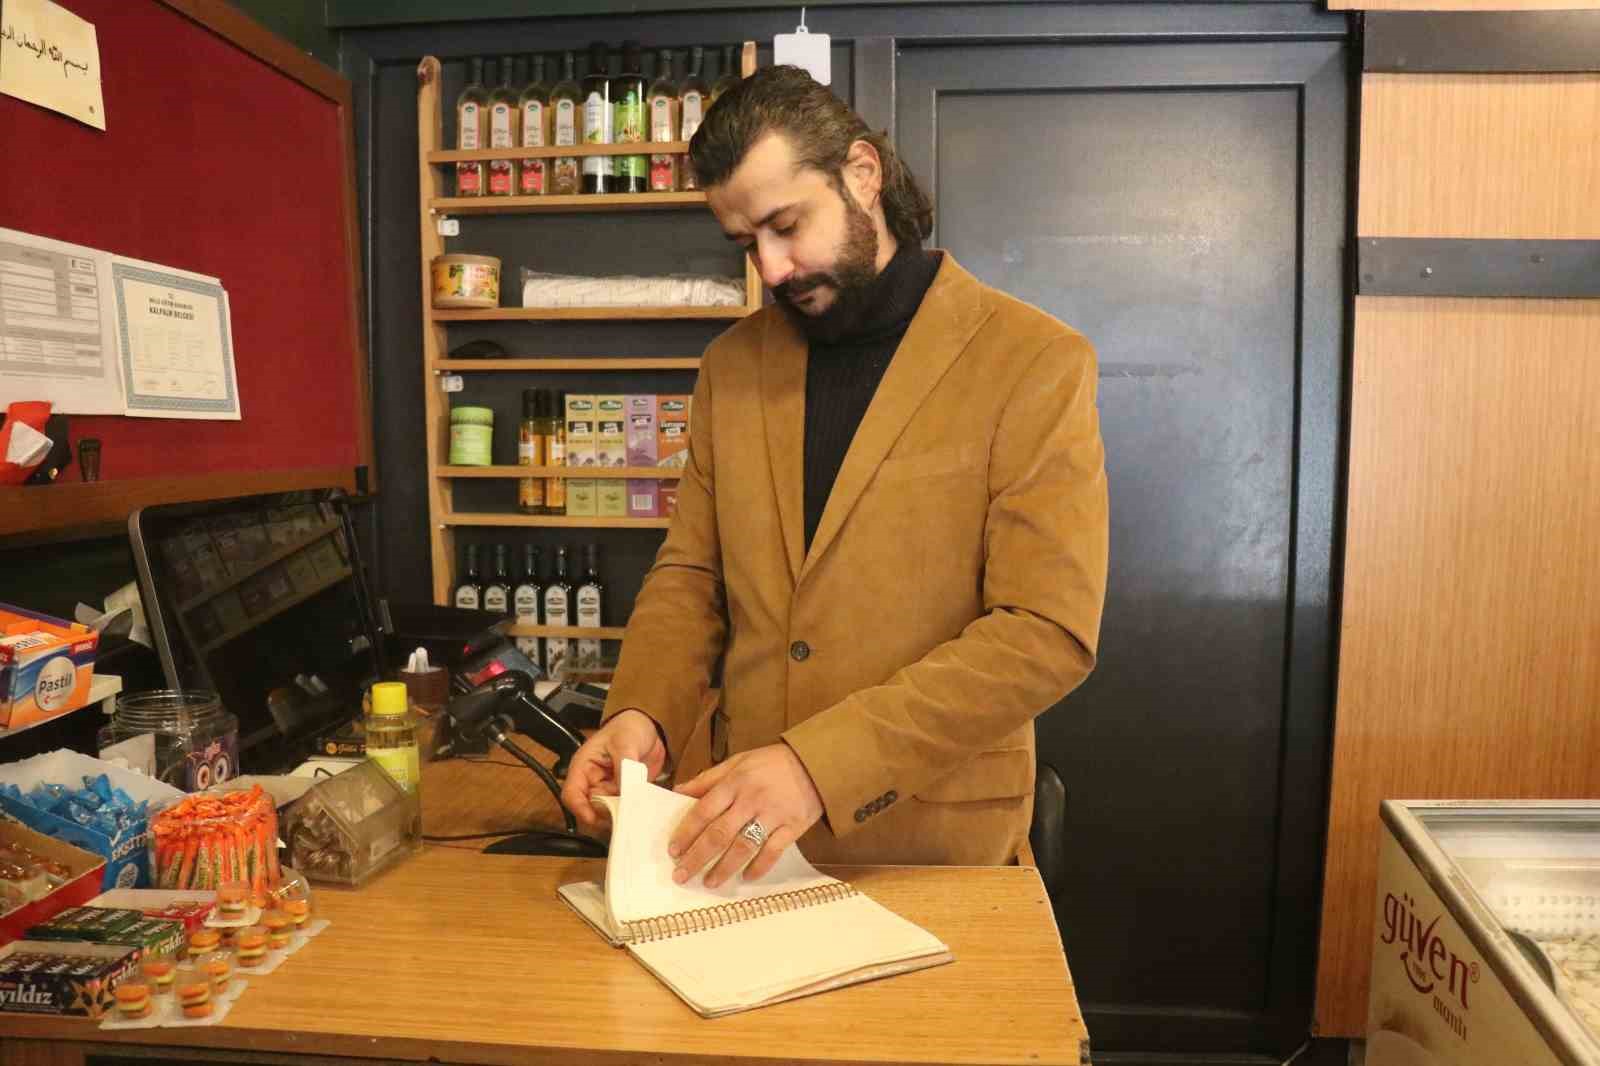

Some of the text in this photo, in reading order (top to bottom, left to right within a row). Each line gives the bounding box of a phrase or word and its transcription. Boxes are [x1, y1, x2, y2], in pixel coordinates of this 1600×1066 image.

[64, 59, 89, 79] بسم
[39, 673, 72, 694] Pastil
[1381, 890, 1469, 1010] güven
[0, 983, 53, 1007] yıldız
